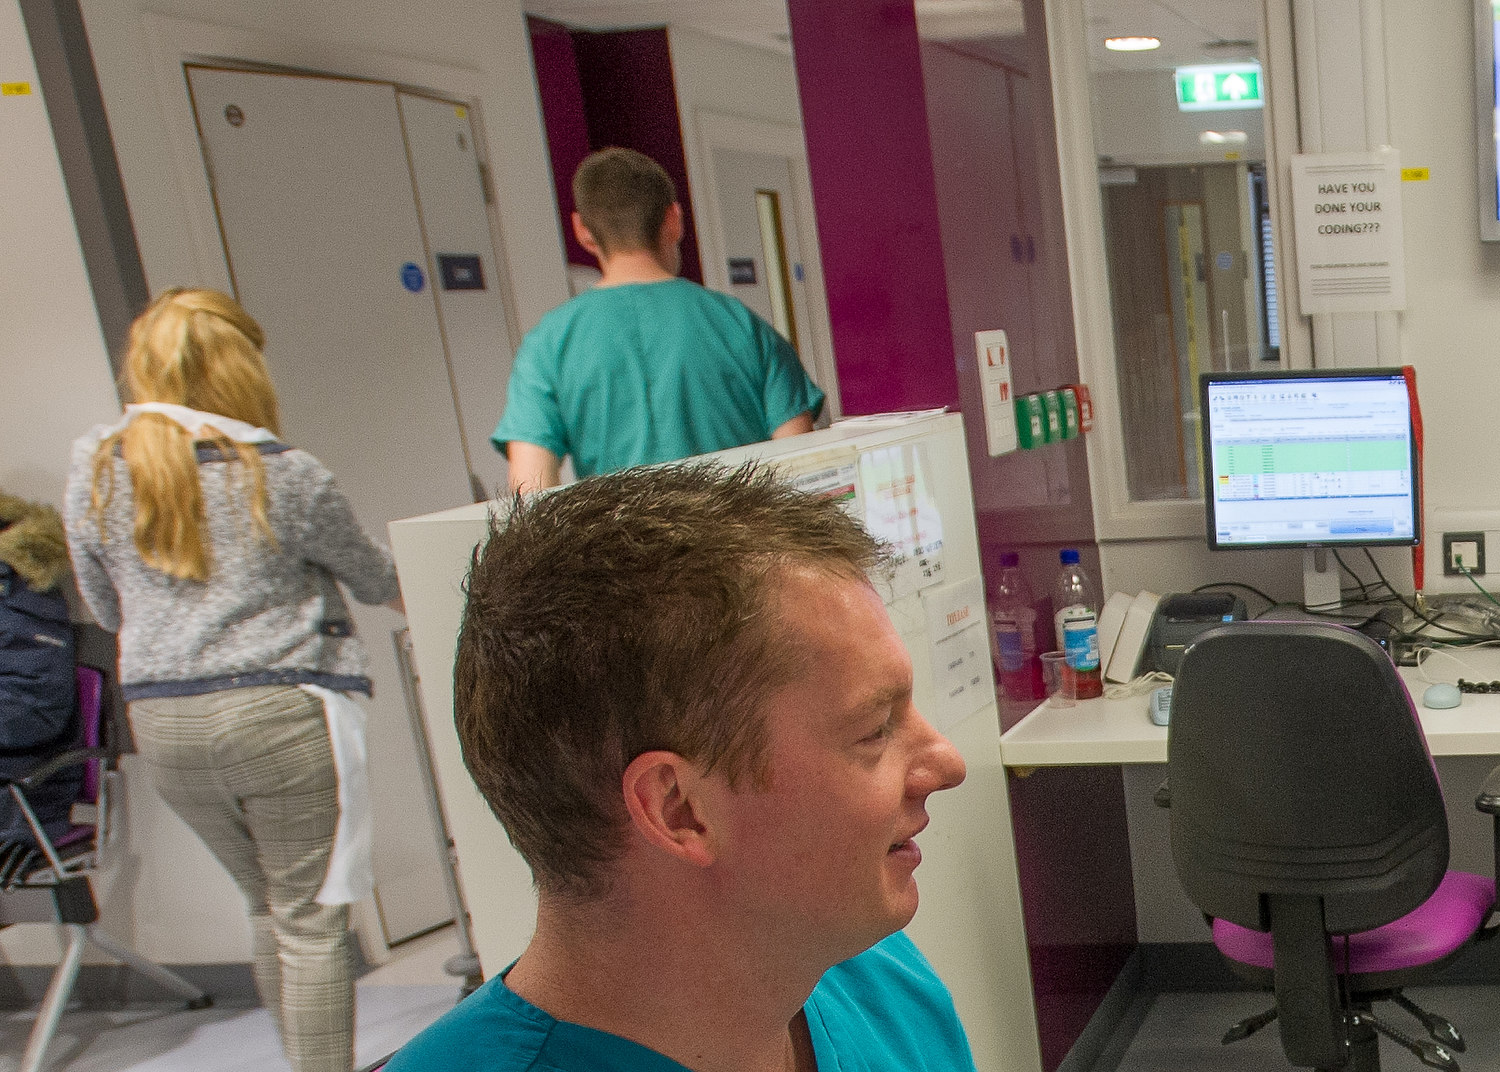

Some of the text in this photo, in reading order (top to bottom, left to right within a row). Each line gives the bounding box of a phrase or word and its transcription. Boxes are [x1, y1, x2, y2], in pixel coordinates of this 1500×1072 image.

[1318, 182, 1375, 194] HAVE YOU
[1315, 201, 1381, 213] DONE YOUR
[1318, 222, 1380, 234] CODING???
